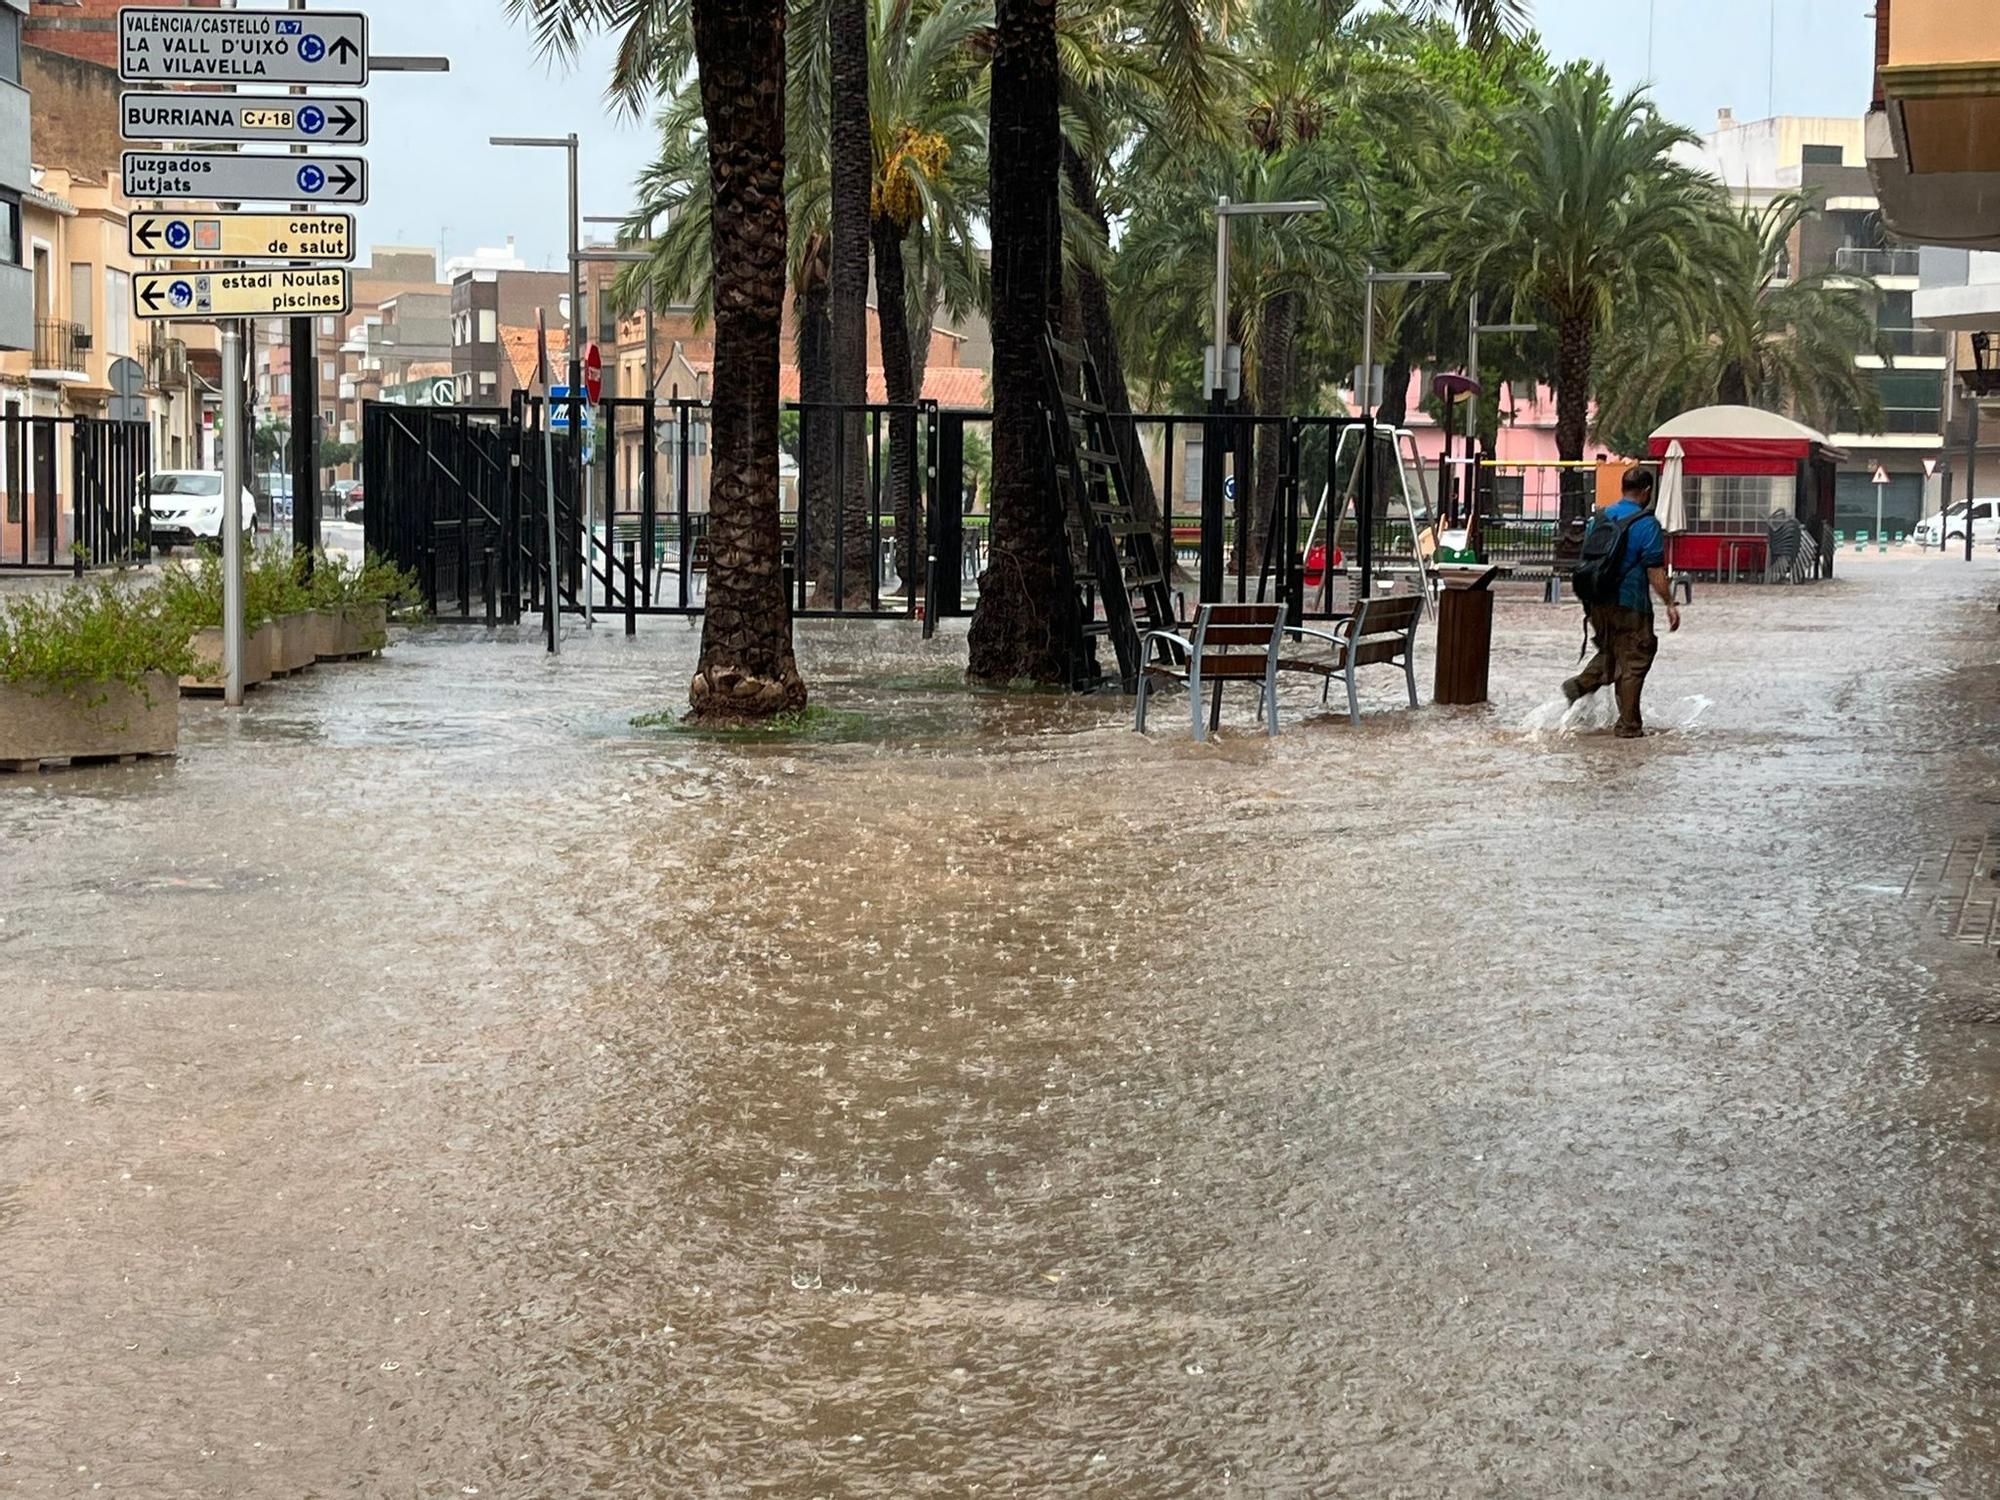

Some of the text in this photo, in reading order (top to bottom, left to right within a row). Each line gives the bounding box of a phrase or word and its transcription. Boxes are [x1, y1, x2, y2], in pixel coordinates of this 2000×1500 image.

[126, 14, 300, 34] VALÈNCIA/CASTELLÓ A-7
[126, 37, 289, 55] LA VALL D'UIXÓ
[126, 57, 266, 75] LA VILAVELLA
[128, 108, 235, 126] BURRIANA
[129, 156, 212, 175] juzgados
[129, 176, 191, 194] jutjats
[289, 220, 344, 234] centre
[268, 239, 344, 254] de salut
[222, 272, 340, 289] estadi Noulas
[273, 292, 340, 311] piscines
